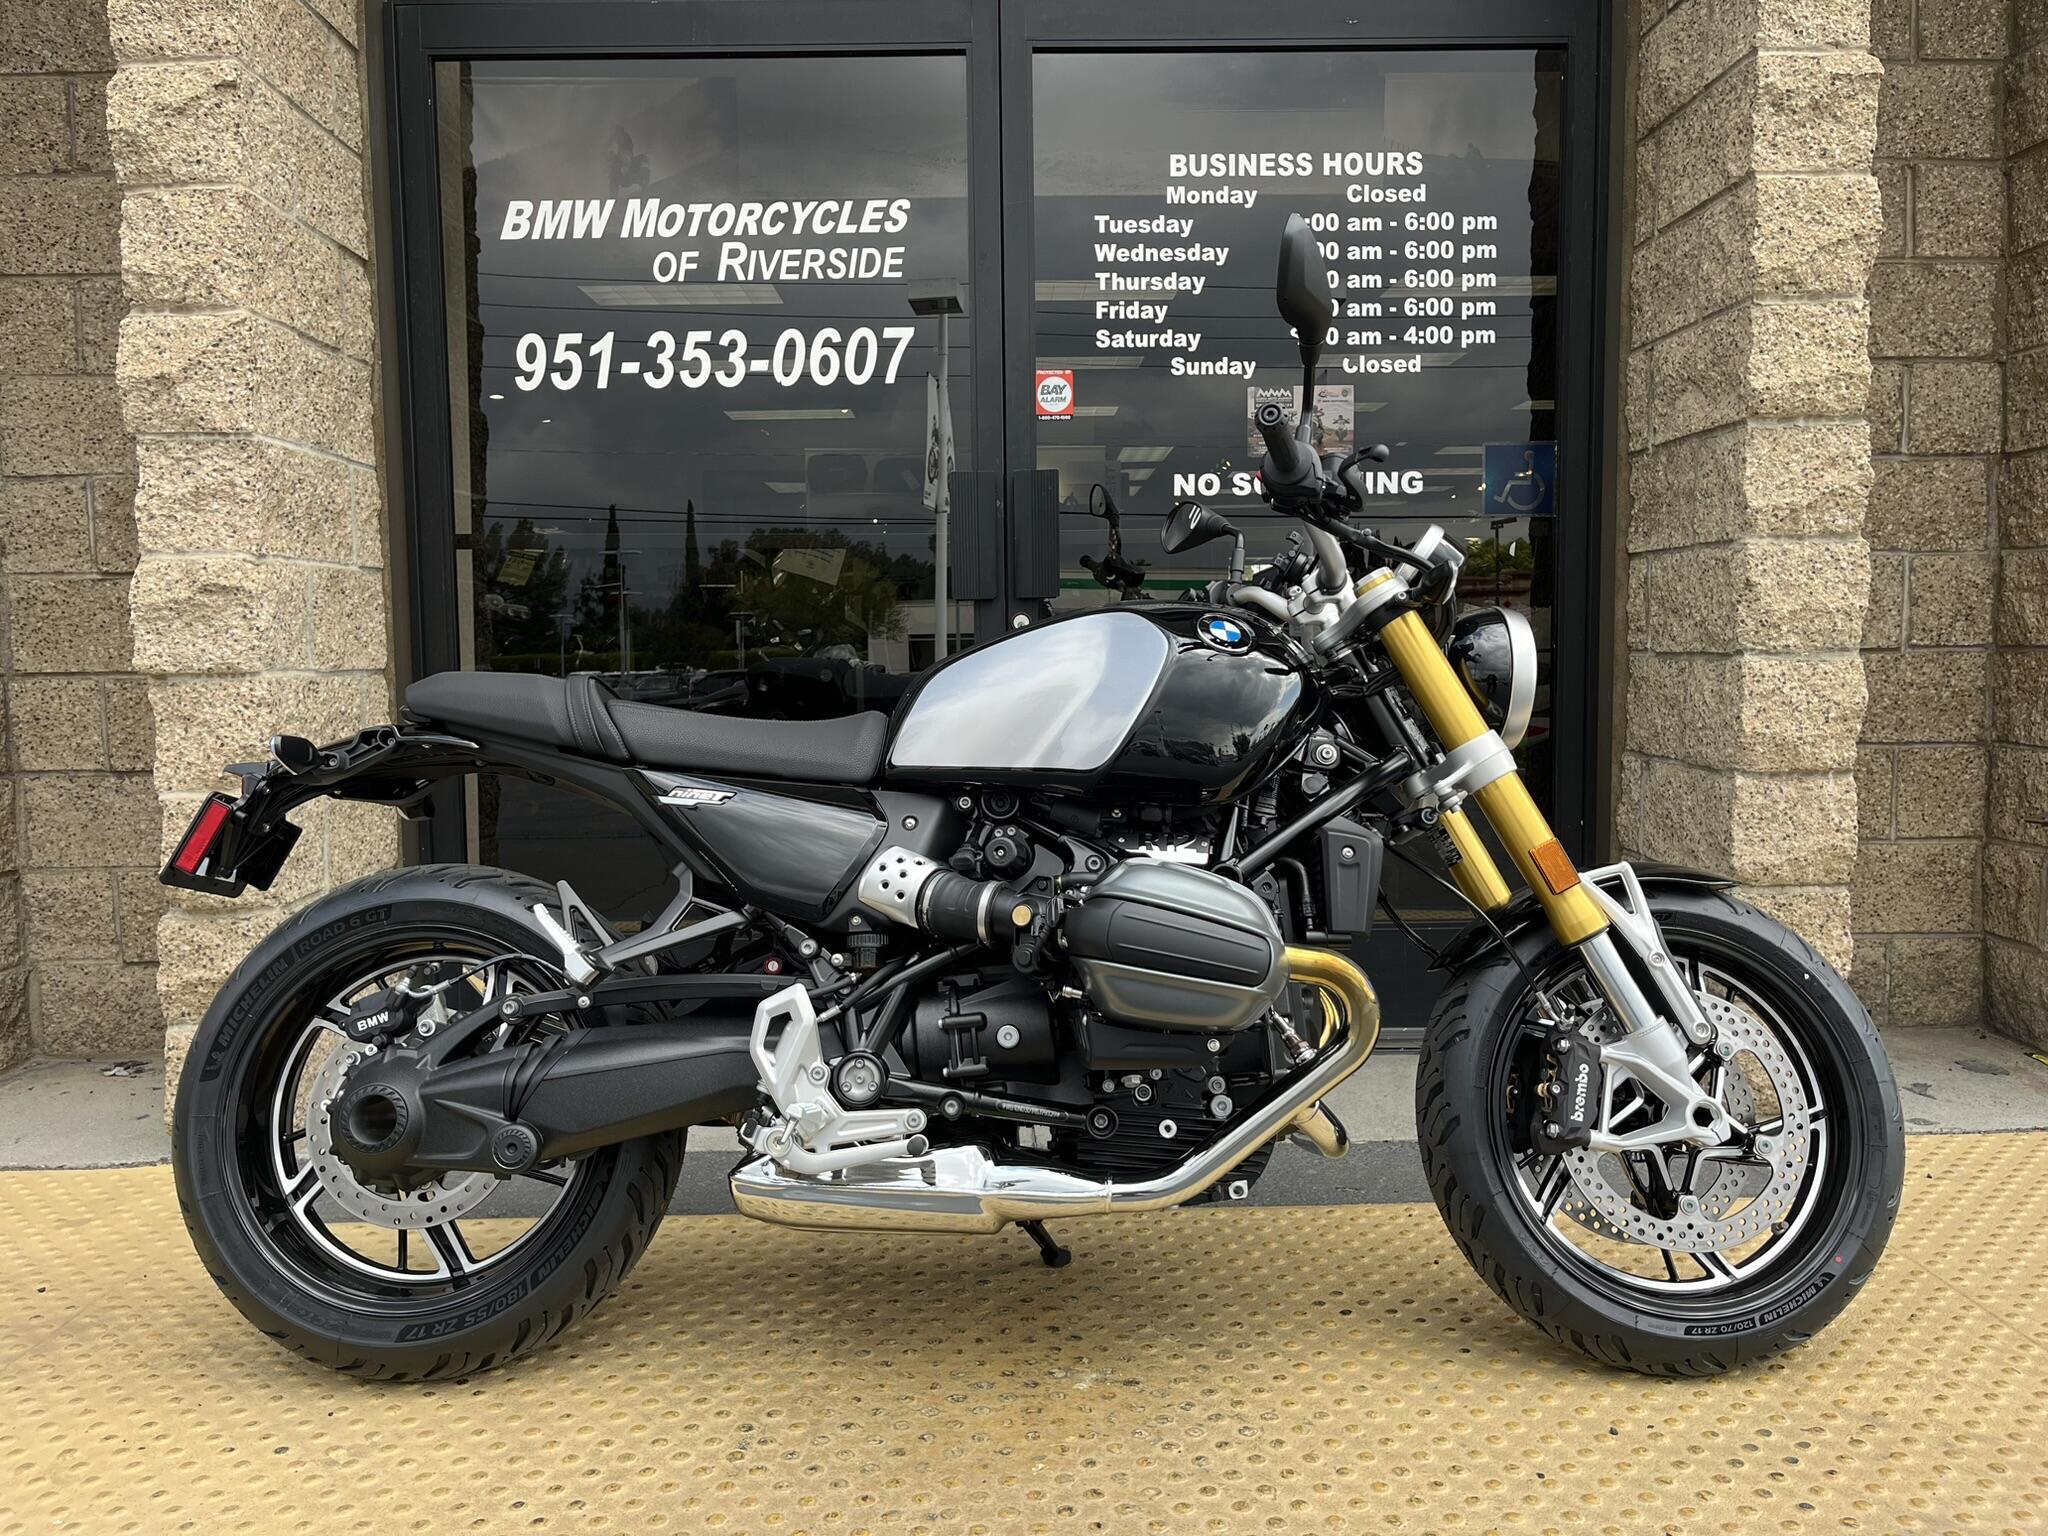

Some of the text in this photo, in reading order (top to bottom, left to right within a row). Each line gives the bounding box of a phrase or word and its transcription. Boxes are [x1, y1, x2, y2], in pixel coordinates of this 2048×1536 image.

[1169, 151, 1424, 178] BUSINESS HOURS
[1166, 183, 1427, 209] Monday Closed
[499, 198, 911, 240] BMW MOTORCYCLES
[1094, 214, 1194, 238] Tuesday
[1346, 217, 1383, 232] am
[1404, 211, 1455, 231] 6:00
[1462, 215, 1497, 235] pm
[653, 242, 906, 282] OF RIVERSIDE
[1094, 242, 1230, 266] Wednesday
[1346, 245, 1383, 260] am
[1404, 240, 1455, 260] 6:00
[1462, 244, 1497, 264] pm
[1094, 271, 1206, 295] Thursday
[1346, 274, 1382, 289] am
[1404, 268, 1454, 288] 6:00
[1461, 272, 1497, 292] pm
[1096, 300, 1169, 324] Friday
[1346, 302, 1382, 317] am
[1404, 297, 1454, 317] 6:00
[1461, 301, 1496, 321] pm
[1095, 328, 1202, 352] Saturday
[1346, 331, 1382, 346] am
[1403, 325, 1454, 345] 4:00
[1461, 329, 1496, 349] pm
[514, 326, 916, 392] 951-353-0607
[1170, 354, 1422, 378] Sunday Closed
[1040, 384, 1067, 395] BAY
[1173, 473, 1221, 497] NO
[300, 906, 389, 955] ROAD 6 GT
[217, 957, 290, 1049] MICHELIN
[356, 1010, 390, 1032] BMW
[1570, 1063, 1590, 1122] brembo
[405, 1285, 526, 1339] 180/55 ZR 17
[1764, 1285, 1817, 1322] MICHELIN
[1690, 1320, 1754, 1335] 120/70 ZR 17
